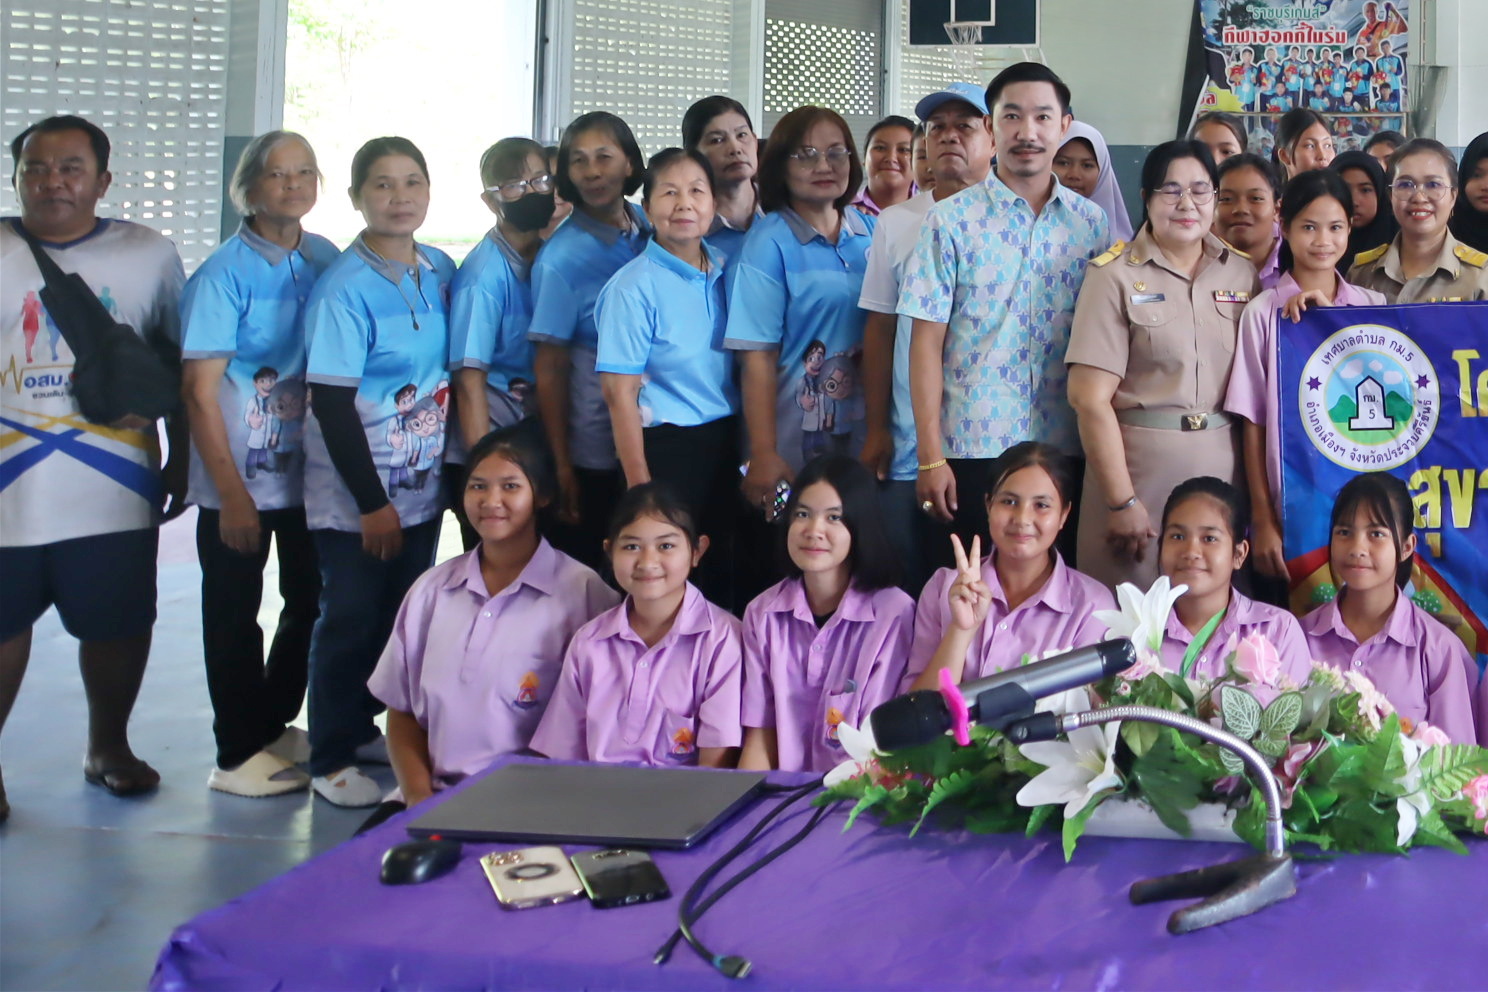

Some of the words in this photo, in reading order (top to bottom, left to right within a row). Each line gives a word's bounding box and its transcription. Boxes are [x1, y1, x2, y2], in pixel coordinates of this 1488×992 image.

[1222, 22, 1349, 45] กีฬาฮอกกี้ในร่ม
[1321, 330, 1386, 366] เทศบาลตำบล
[1363, 394, 1379, 403] กม.
[1369, 409, 1376, 419] 5
[1306, 401, 1346, 457] อำเภอเมืองฯ
